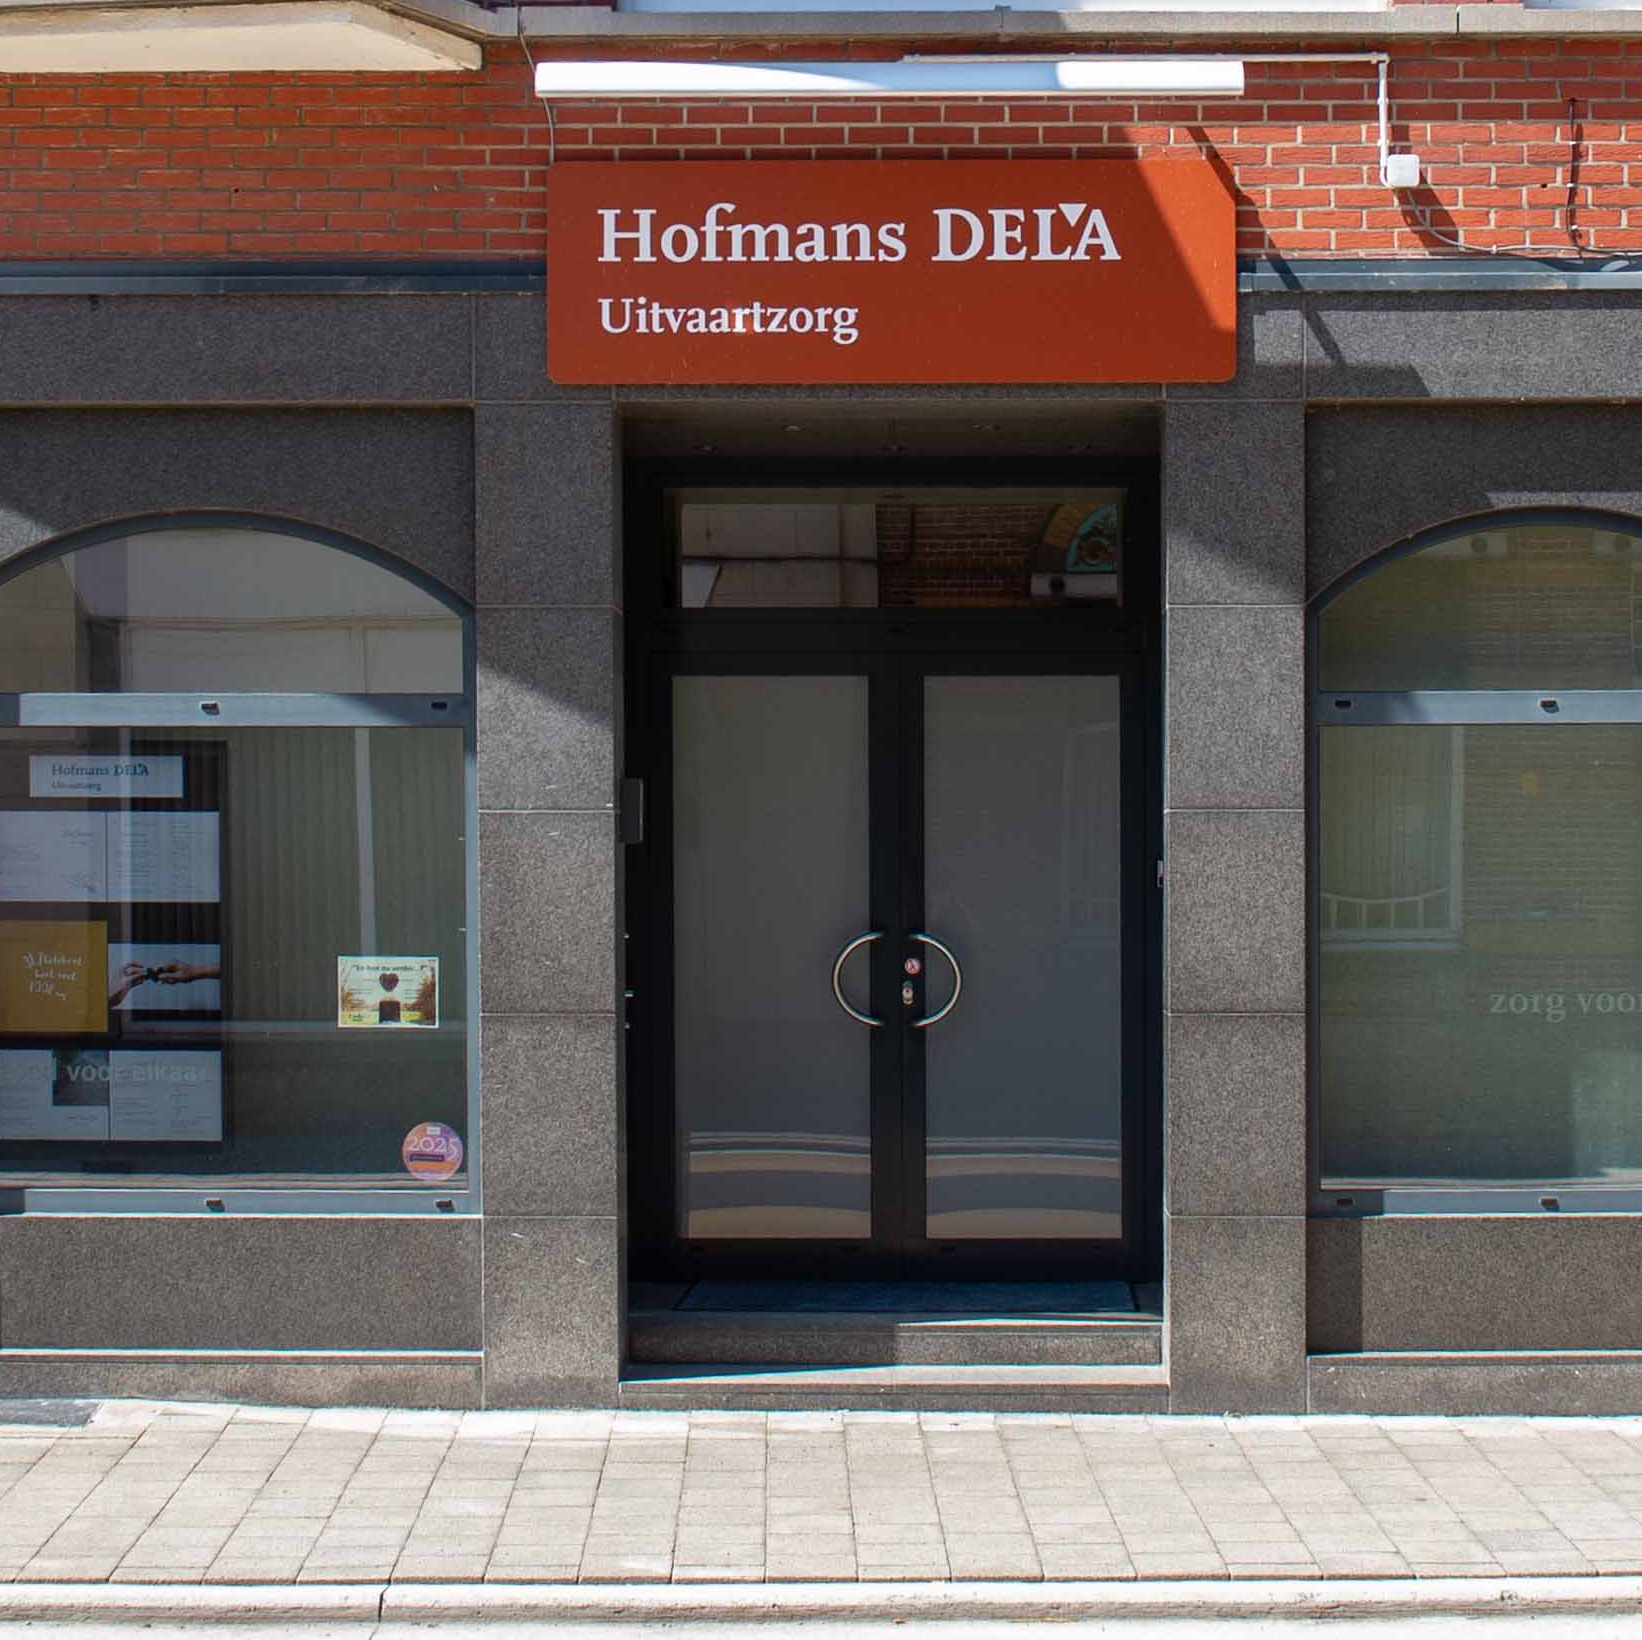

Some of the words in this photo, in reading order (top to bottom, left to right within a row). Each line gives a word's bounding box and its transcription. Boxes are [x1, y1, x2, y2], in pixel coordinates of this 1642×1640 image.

[597, 202, 907, 263] Hofmans
[931, 202, 1122, 262] DELA
[598, 295, 859, 344] Uitvaartzorg
[1489, 990, 1567, 1023] zorg
